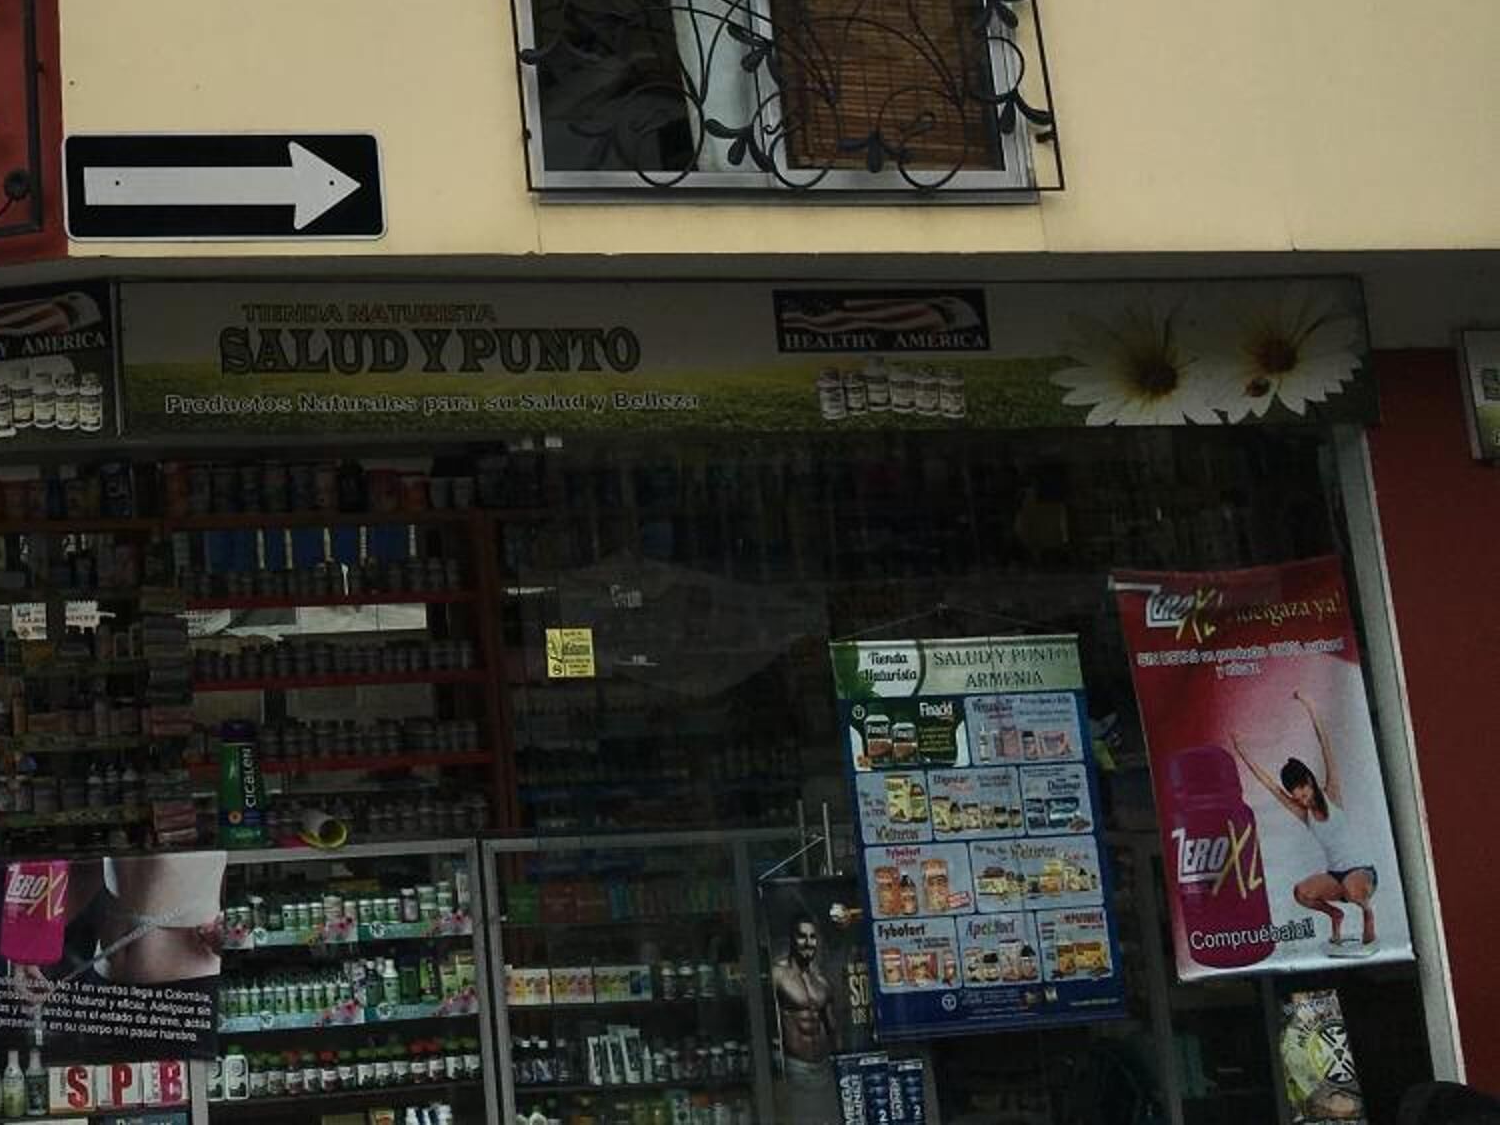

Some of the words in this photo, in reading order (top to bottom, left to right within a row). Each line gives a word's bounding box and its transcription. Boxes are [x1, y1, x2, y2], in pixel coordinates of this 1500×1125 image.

[242, 304, 342, 324] TIENDA
[22, 331, 107, 356] AMERICA
[785, 332, 880, 349] HEALTHY
[893, 332, 986, 349] AMERICA
[164, 393, 293, 414] Productos
[298, 392, 420, 413] Naturales
[423, 395, 479, 416] para
[612, 391, 701, 412] Belleza
[867, 650, 909, 666] Tienda
[965, 670, 1045, 688] ARMENIA
